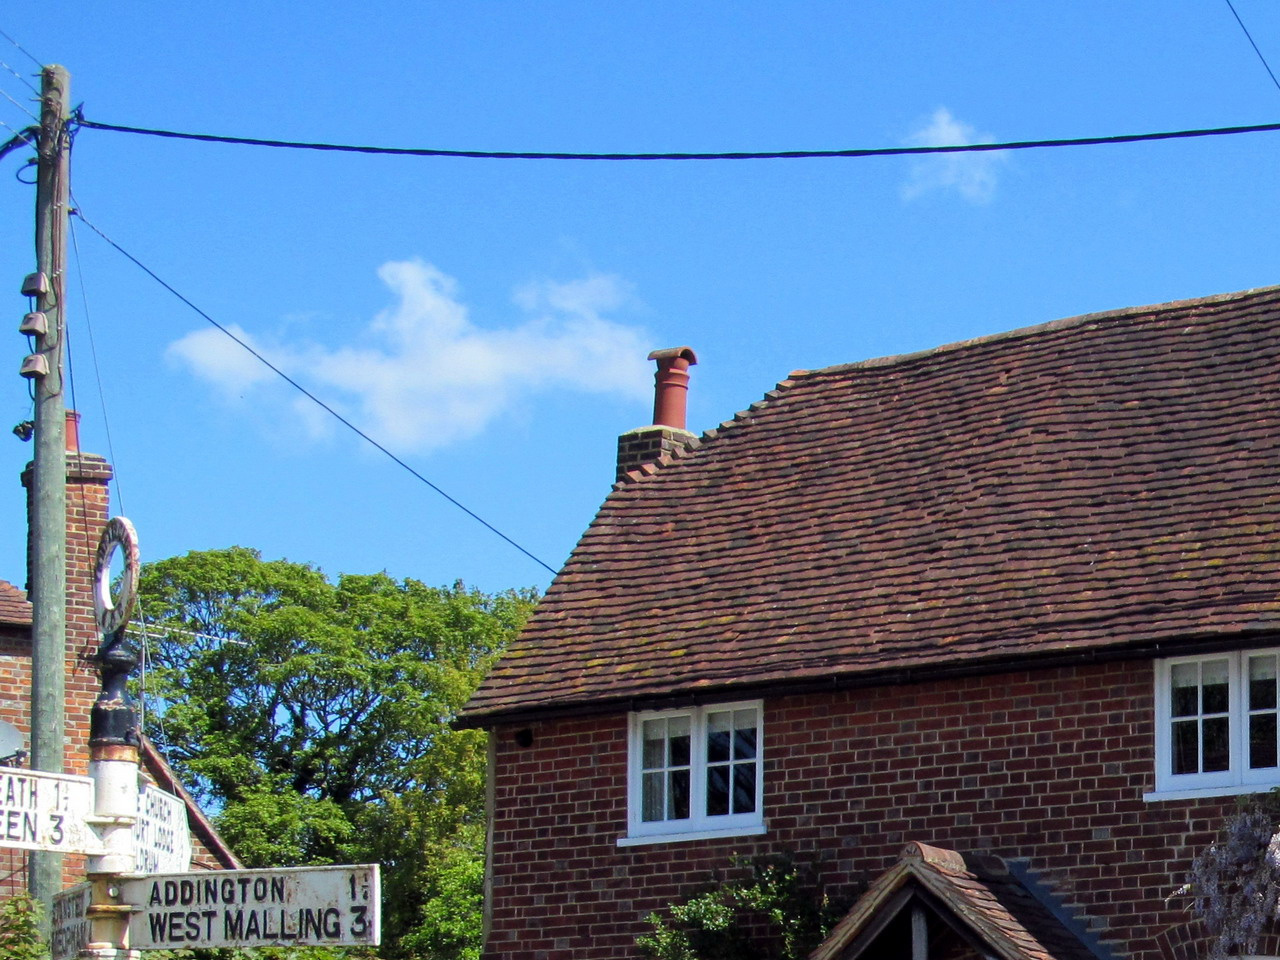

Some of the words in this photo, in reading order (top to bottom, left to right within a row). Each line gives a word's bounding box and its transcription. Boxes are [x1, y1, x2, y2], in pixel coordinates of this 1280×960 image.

[0, 773, 38, 810] ATH
[49, 814, 65, 846] 3
[150, 876, 285, 907] ADDINGTON
[149, 910, 218, 943] WEST
[224, 907, 342, 941] MALLING
[350, 905, 368, 937] 3
